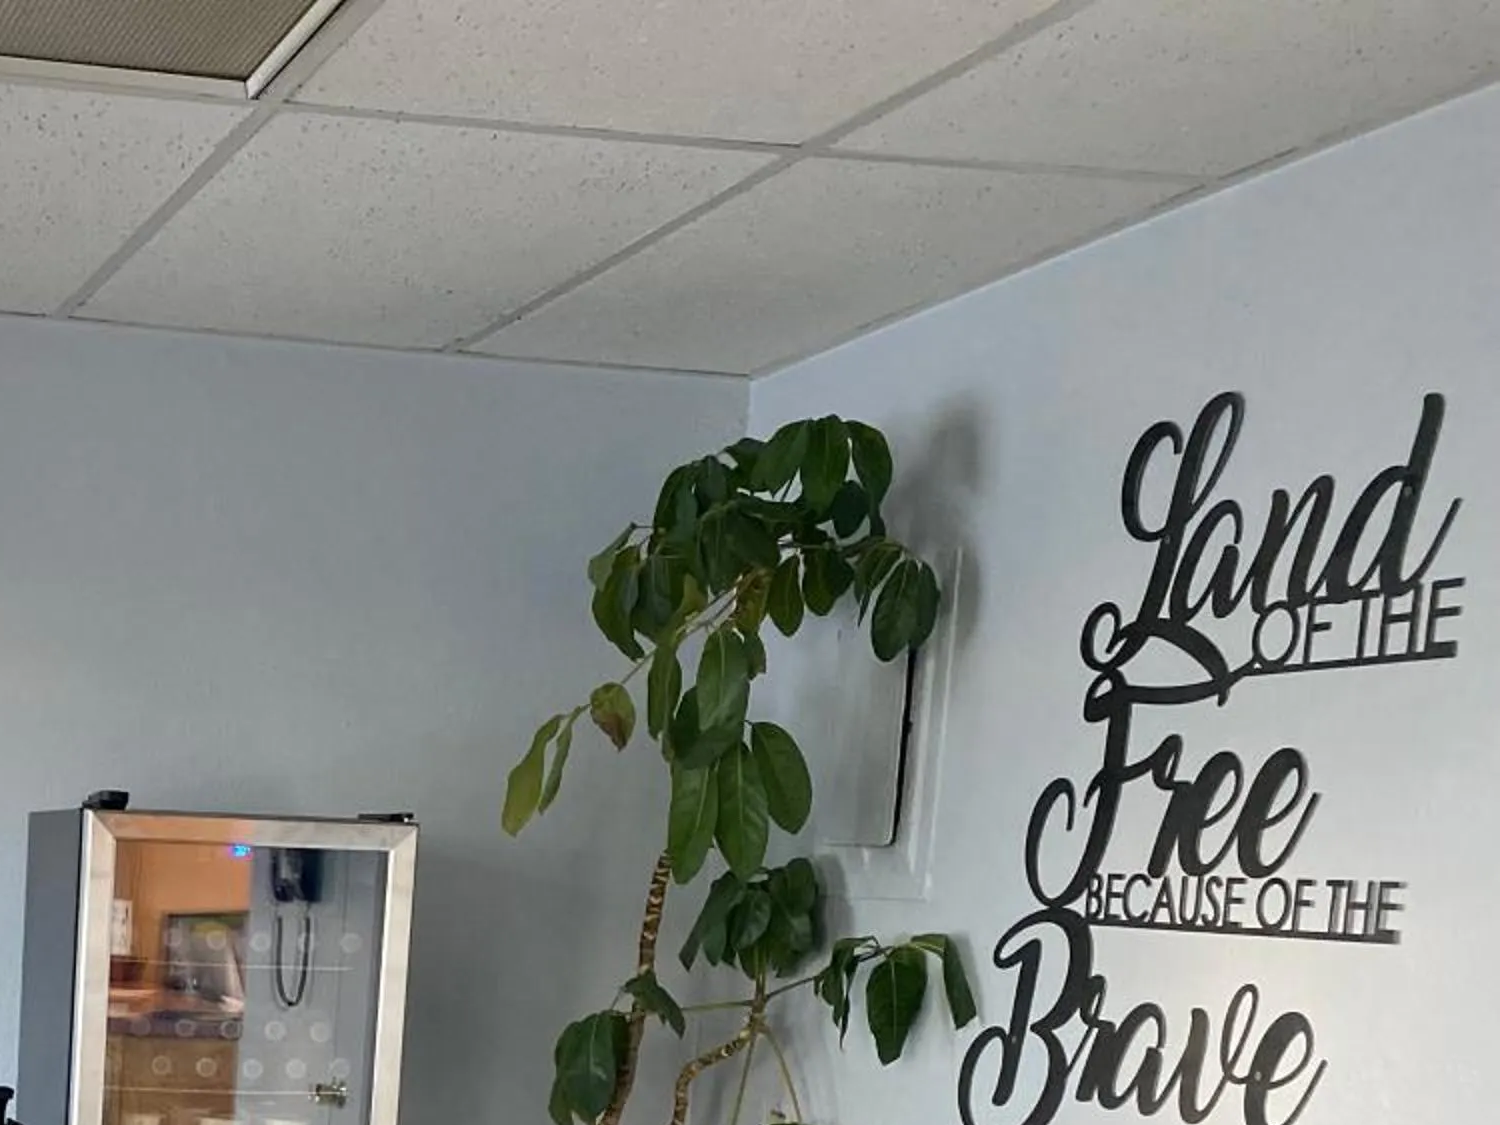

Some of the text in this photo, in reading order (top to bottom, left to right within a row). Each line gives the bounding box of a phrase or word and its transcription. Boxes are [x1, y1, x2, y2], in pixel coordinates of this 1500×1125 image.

[1081, 391, 1464, 676] Land
[1251, 577, 1466, 665] OF THE
[1025, 668, 1322, 908] Free
[1085, 873, 1407, 940] BECAUSE OF THE
